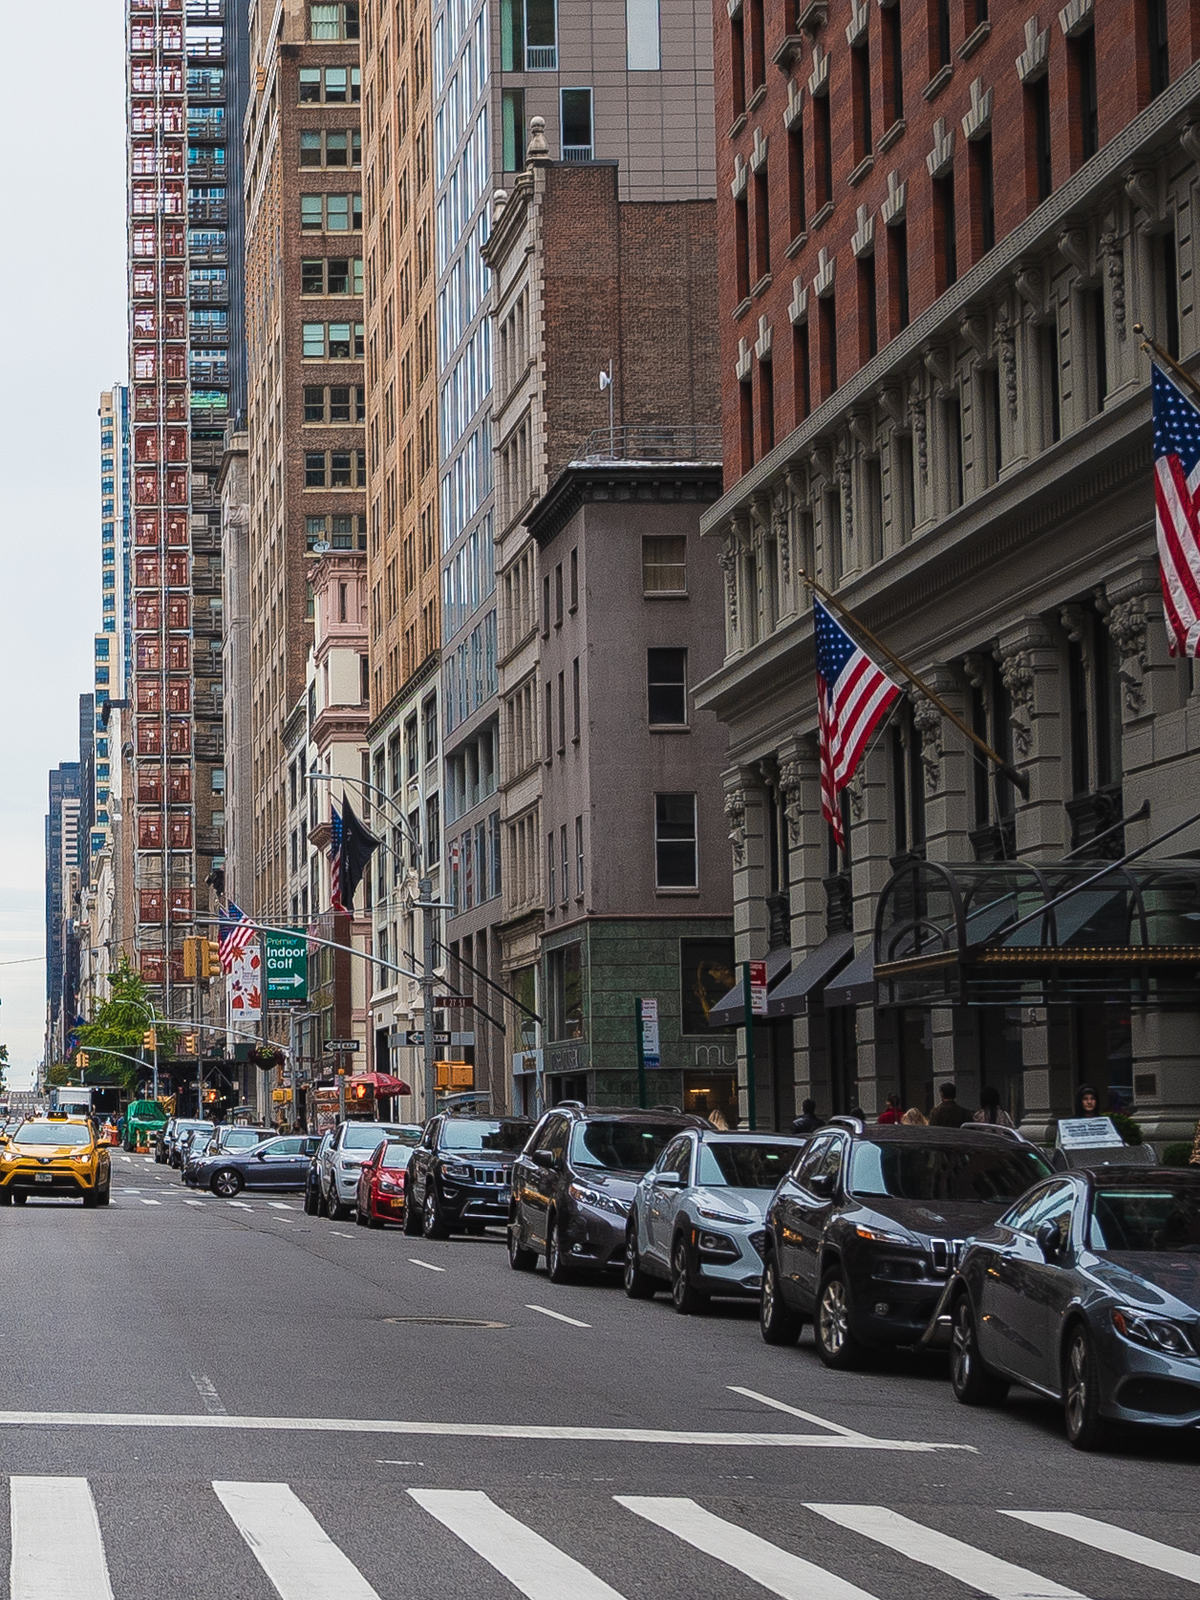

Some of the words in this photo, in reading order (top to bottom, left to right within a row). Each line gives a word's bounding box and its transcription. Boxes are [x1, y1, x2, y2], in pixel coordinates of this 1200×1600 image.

[267, 937, 298, 946] Premier
[267, 946, 306, 957] Indoor
[267, 958, 293, 969] Golf
[449, 999, 457, 1007] 27
